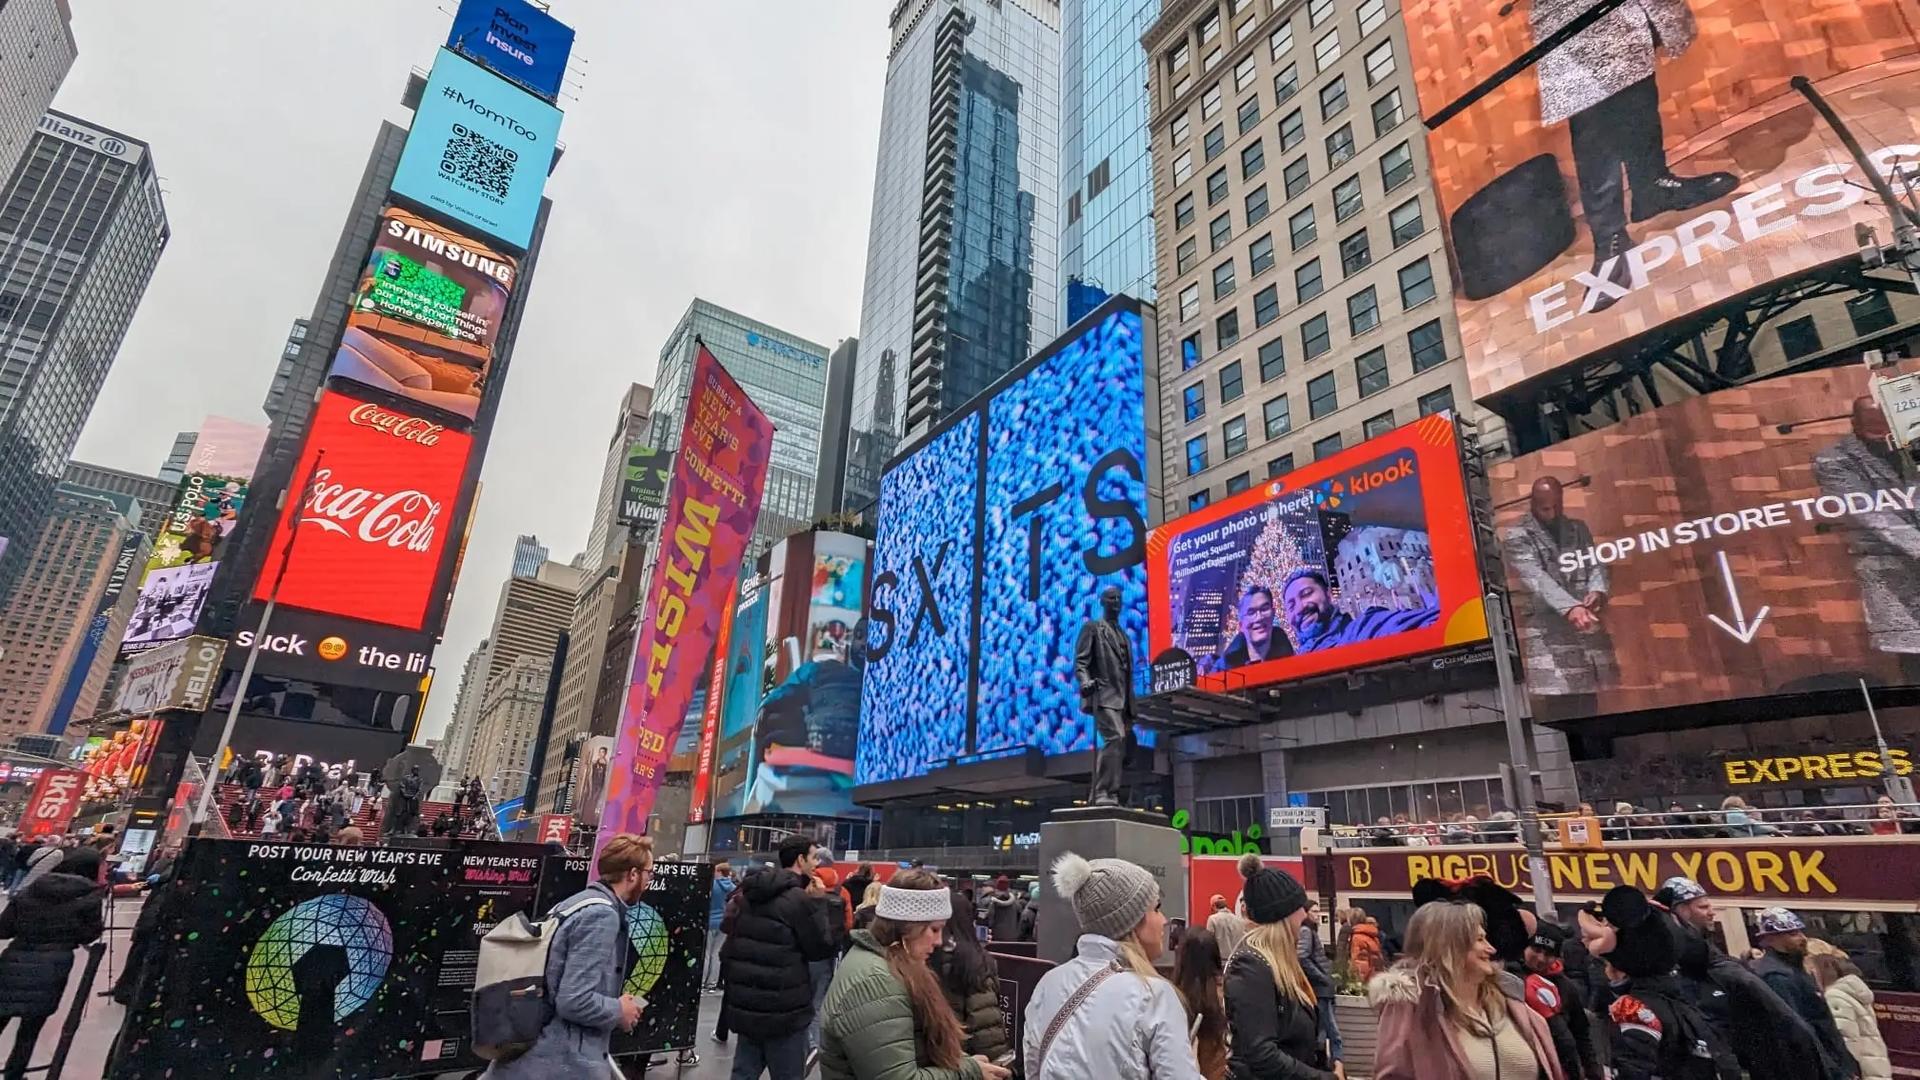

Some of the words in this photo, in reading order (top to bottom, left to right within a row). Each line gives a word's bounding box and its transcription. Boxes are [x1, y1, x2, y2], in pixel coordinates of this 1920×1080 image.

[490, 19, 537, 53] Invest
[494, 7, 529, 35] Plan
[485, 31, 534, 66] Insure
[39, 116, 97, 146] llianz
[442, 86, 537, 141] #MomToo
[438, 171, 466, 189] WATCH
[467, 186, 480, 197] MY
[481, 191, 505, 206] STORY
[387, 220, 511, 282] SAMSUNG
[1529, 143, 1920, 333] EXPRESS
[375, 289, 394, 301] our
[396, 295, 420, 309] new
[379, 300, 413, 317] Home
[382, 281, 432, 304] Immerse
[433, 301, 475, 321] yourself
[702, 385, 730, 422] NEW
[708, 374, 736, 409] SUBMIT
[735, 406, 742, 417] A
[349, 403, 444, 446] Coca-Cola
[691, 419, 714, 451] EVE
[698, 403, 740, 452] YEAR'S
[182, 476, 204, 511] POLO
[684, 447, 747, 508] CONFETTI
[1351, 458, 1414, 496] klook
[1173, 537, 1192, 555] Get
[1193, 529, 1219, 548] your
[1221, 515, 1258, 542] photo
[1279, 490, 1314, 513] here!
[1558, 537, 1636, 573] SHOP
[1640, 527, 1671, 553] IN
[1673, 503, 1791, 545] STORE
[1792, 486, 1917, 521] TODAY
[1175, 556, 1188, 568] The
[1188, 550, 1209, 564] Times
[1210, 539, 1235, 558] Square
[236, 630, 308, 656] suck
[358, 646, 401, 669] the
[181, 641, 220, 708] HELLO!
[699, 731, 712, 775] STORE
[1724, 749, 1914, 784] EXPRESS
[37, 774, 79, 819] tkts
[248, 844, 290, 859] POST
[294, 846, 332, 861] YOUR
[336, 848, 368, 862] NEW
[371, 851, 415, 865] YEAR'S
[418, 853, 442, 866] EVE
[463, 855, 485, 867] NEW
[487, 856, 519, 868] YEAR'S
[520, 858, 538, 869] EVE
[564, 859, 591, 871] POST
[653, 864, 678, 875] EAR'S
[680, 865, 697, 876] EVE
[1550, 852, 1660, 891] NEW
[1673, 850, 1838, 895] YORK
[291, 865, 357, 887] Confetti
[358, 866, 396, 884] Wish
